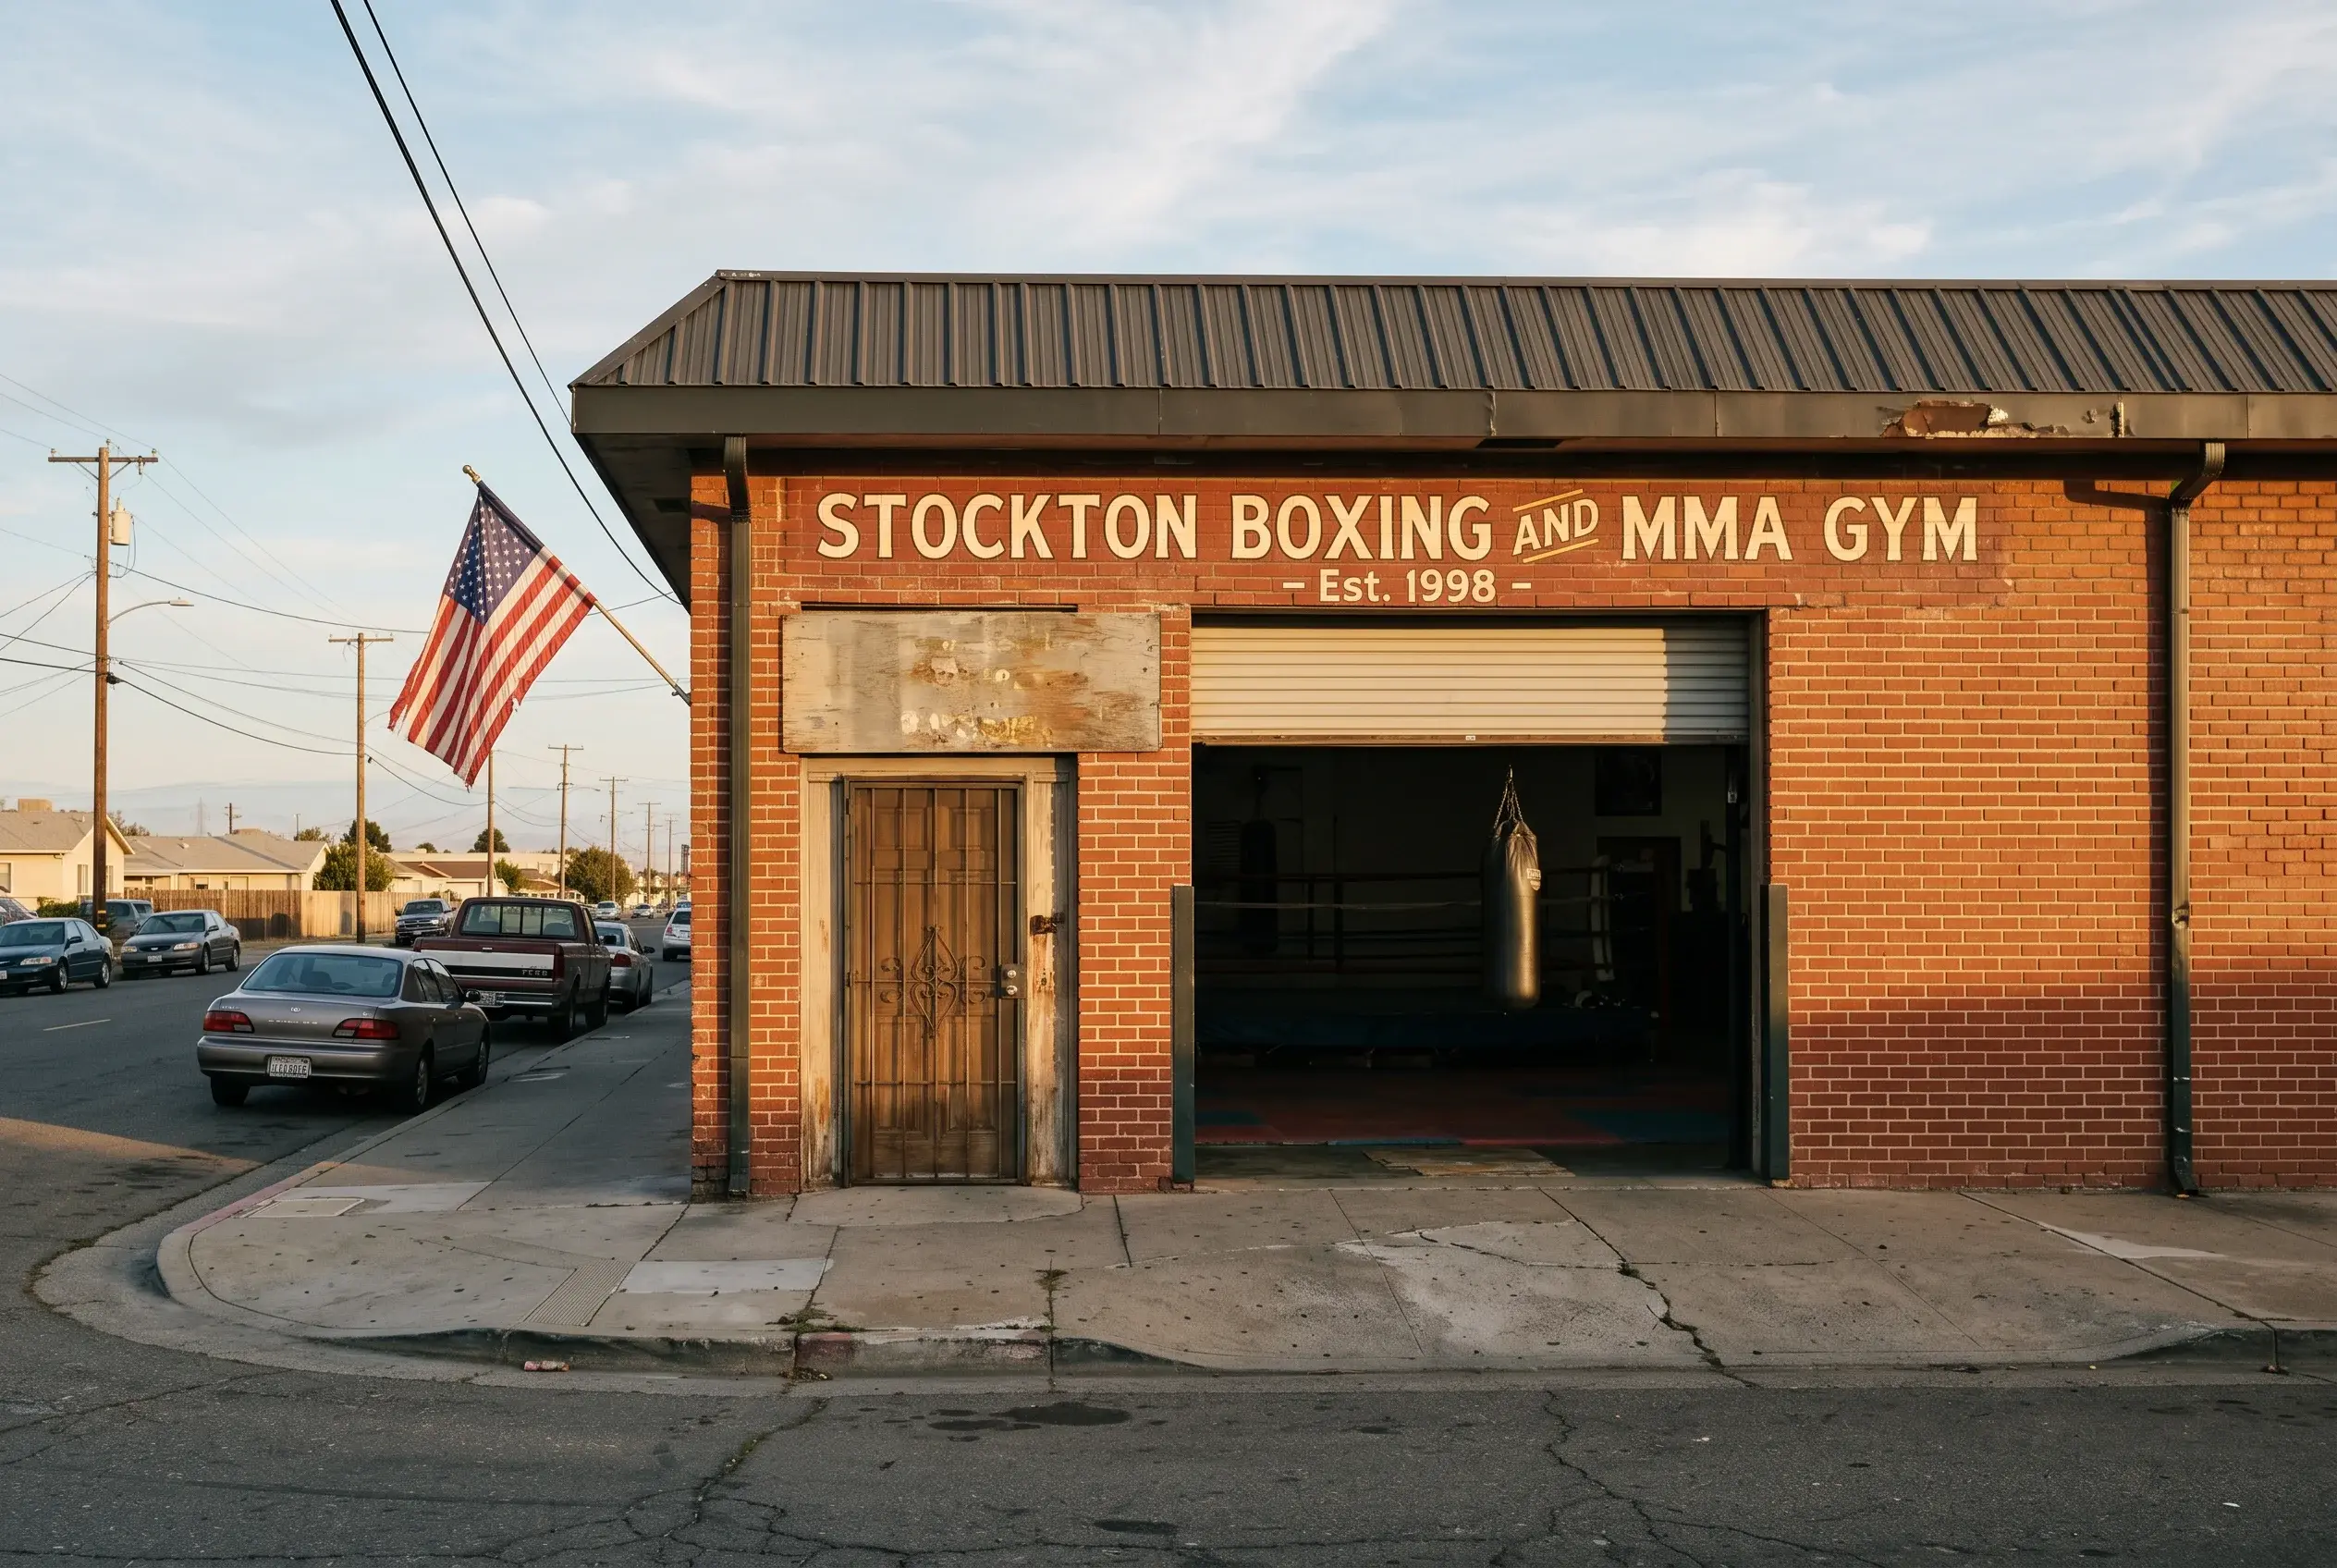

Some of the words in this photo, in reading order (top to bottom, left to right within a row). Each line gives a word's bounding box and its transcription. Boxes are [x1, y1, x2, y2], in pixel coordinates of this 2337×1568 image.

[816, 492, 1198, 560] STOCKTON
[1230, 494, 1493, 561] BOXING
[1511, 497, 1600, 557] AND
[1621, 495, 1794, 561] MMA
[1823, 496, 1978, 562] GYM
[1318, 568, 1392, 604] Est.
[1405, 568, 1497, 604] 1998
